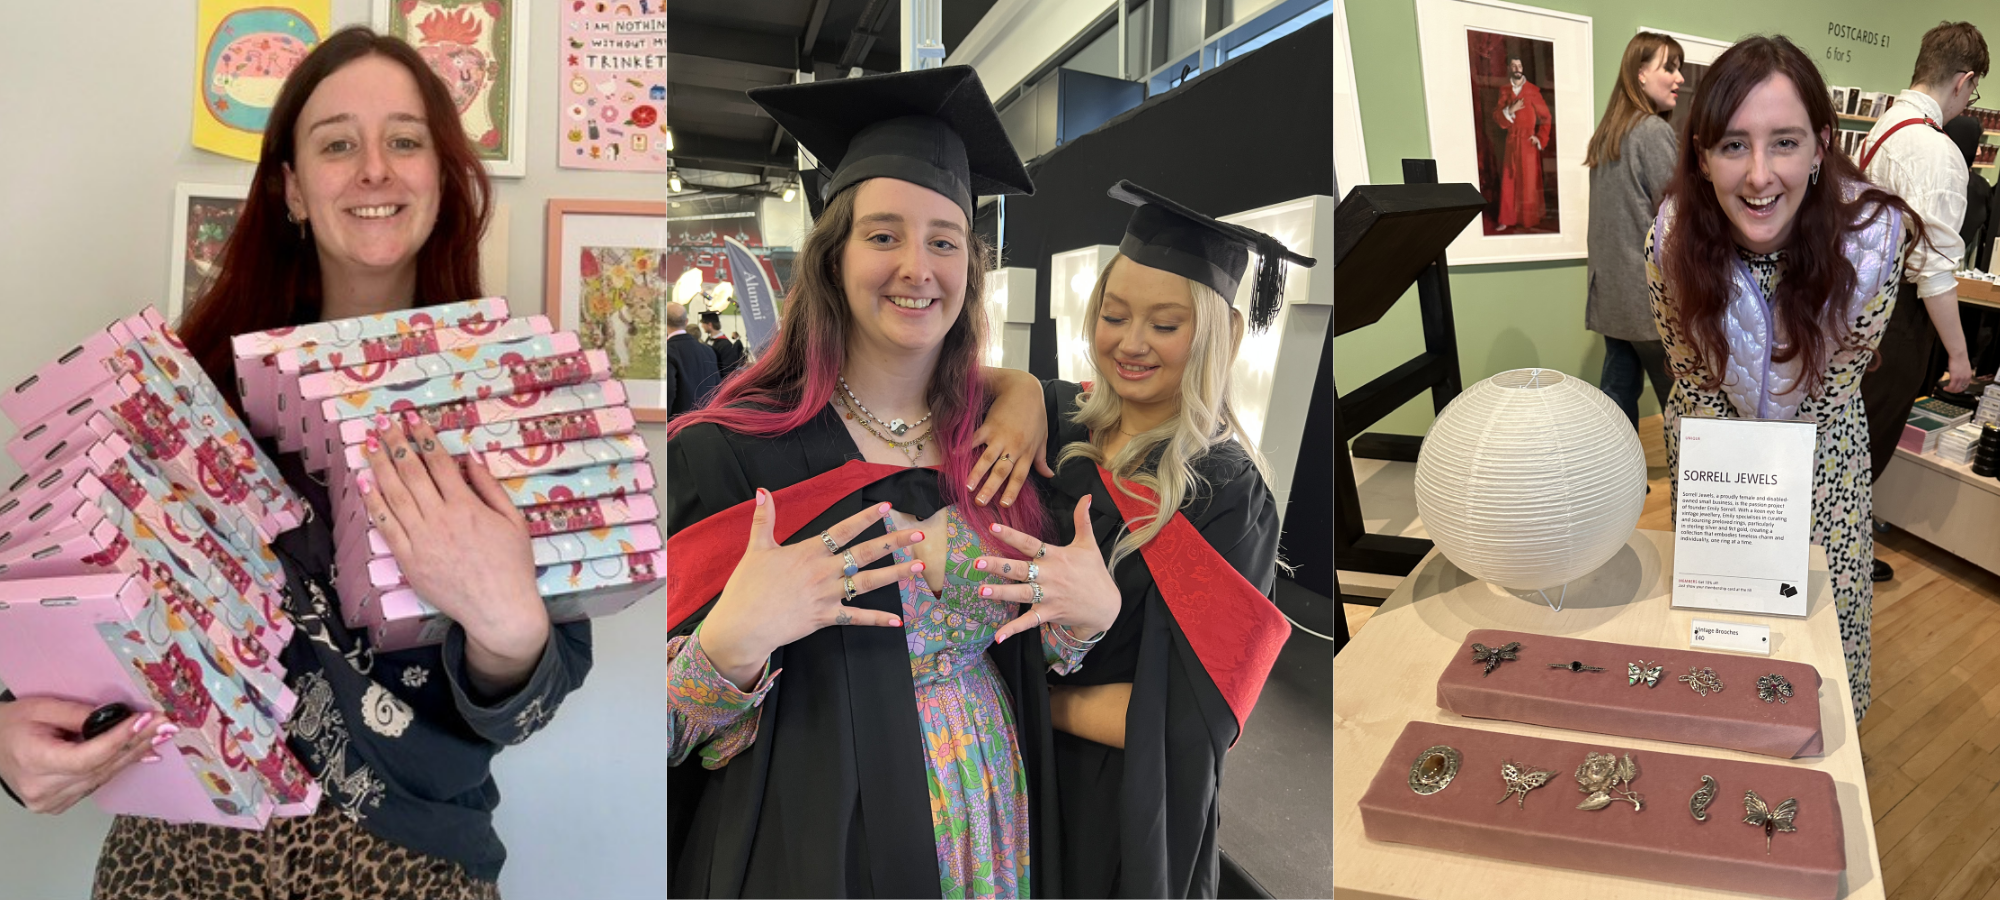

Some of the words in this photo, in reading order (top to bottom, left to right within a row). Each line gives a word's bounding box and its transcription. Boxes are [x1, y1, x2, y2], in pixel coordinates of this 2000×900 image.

[585, 22, 589, 30] I
[594, 22, 610, 31] AM
[1828, 22, 1879, 46] POSTCARDS
[1881, 34, 1890, 48] £1
[592, 40, 646, 48] WITHOUT
[586, 54, 667, 69] TRINKET
[1826, 46, 1832, 59] 6
[1833, 46, 1845, 61] for
[1846, 50, 1851, 63] 5
[743, 271, 766, 320] Alumni
[1683, 470, 1731, 483] SORRELL
[1734, 472, 1778, 485] JEWELS
[1695, 626, 1714, 634] Vintage
[1715, 628, 1739, 636] Brooches
